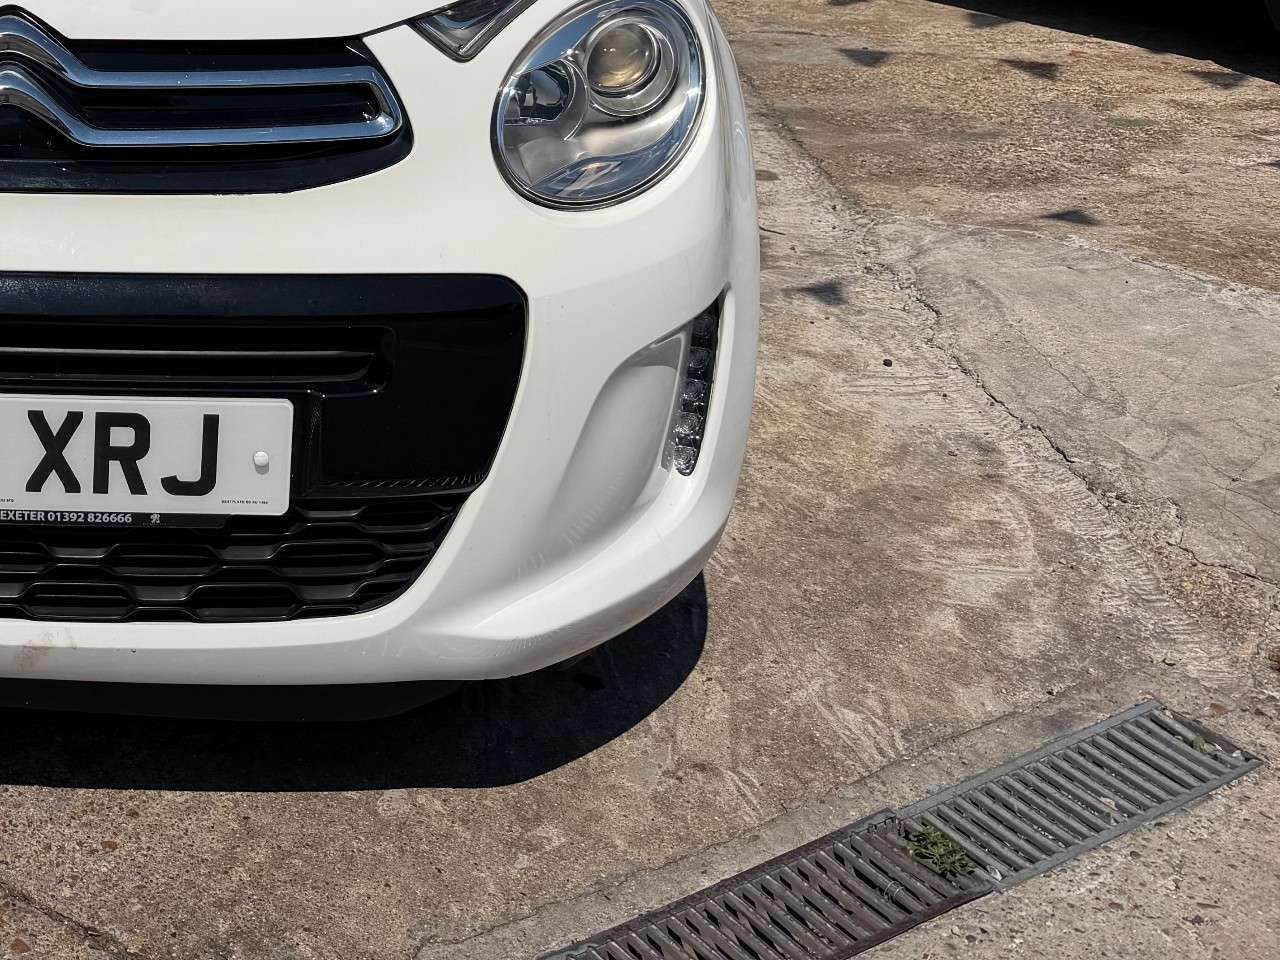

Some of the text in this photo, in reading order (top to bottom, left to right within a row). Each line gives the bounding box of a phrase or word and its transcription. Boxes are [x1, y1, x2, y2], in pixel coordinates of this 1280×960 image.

[25, 409, 220, 496] XRJ
[0, 509, 45, 522] EXETER
[47, 511, 85, 523] 01392
[87, 512, 133, 524] 826666
